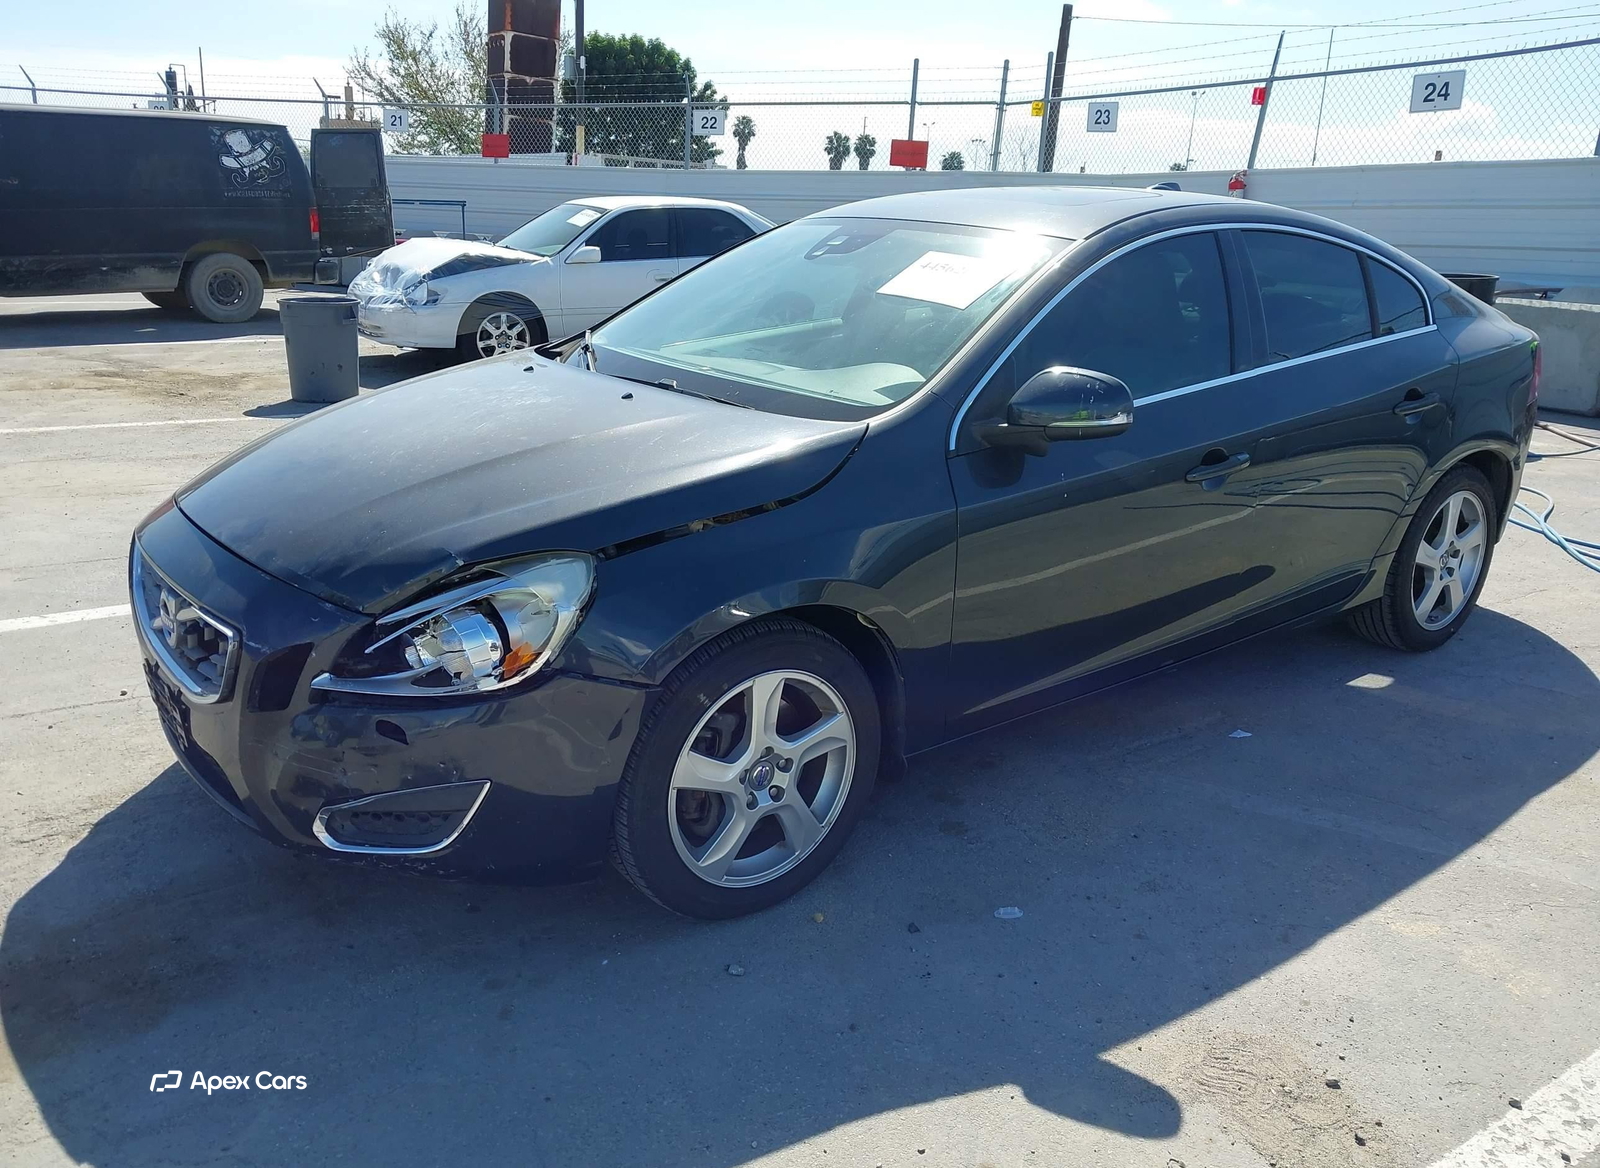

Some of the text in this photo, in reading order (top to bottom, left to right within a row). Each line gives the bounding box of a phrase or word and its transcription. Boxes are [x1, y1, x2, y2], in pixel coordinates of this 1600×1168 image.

[1422, 81, 1451, 103] 24
[390, 114, 403, 127] 21
[701, 116, 718, 130] 22
[1094, 109, 1111, 125] 23
